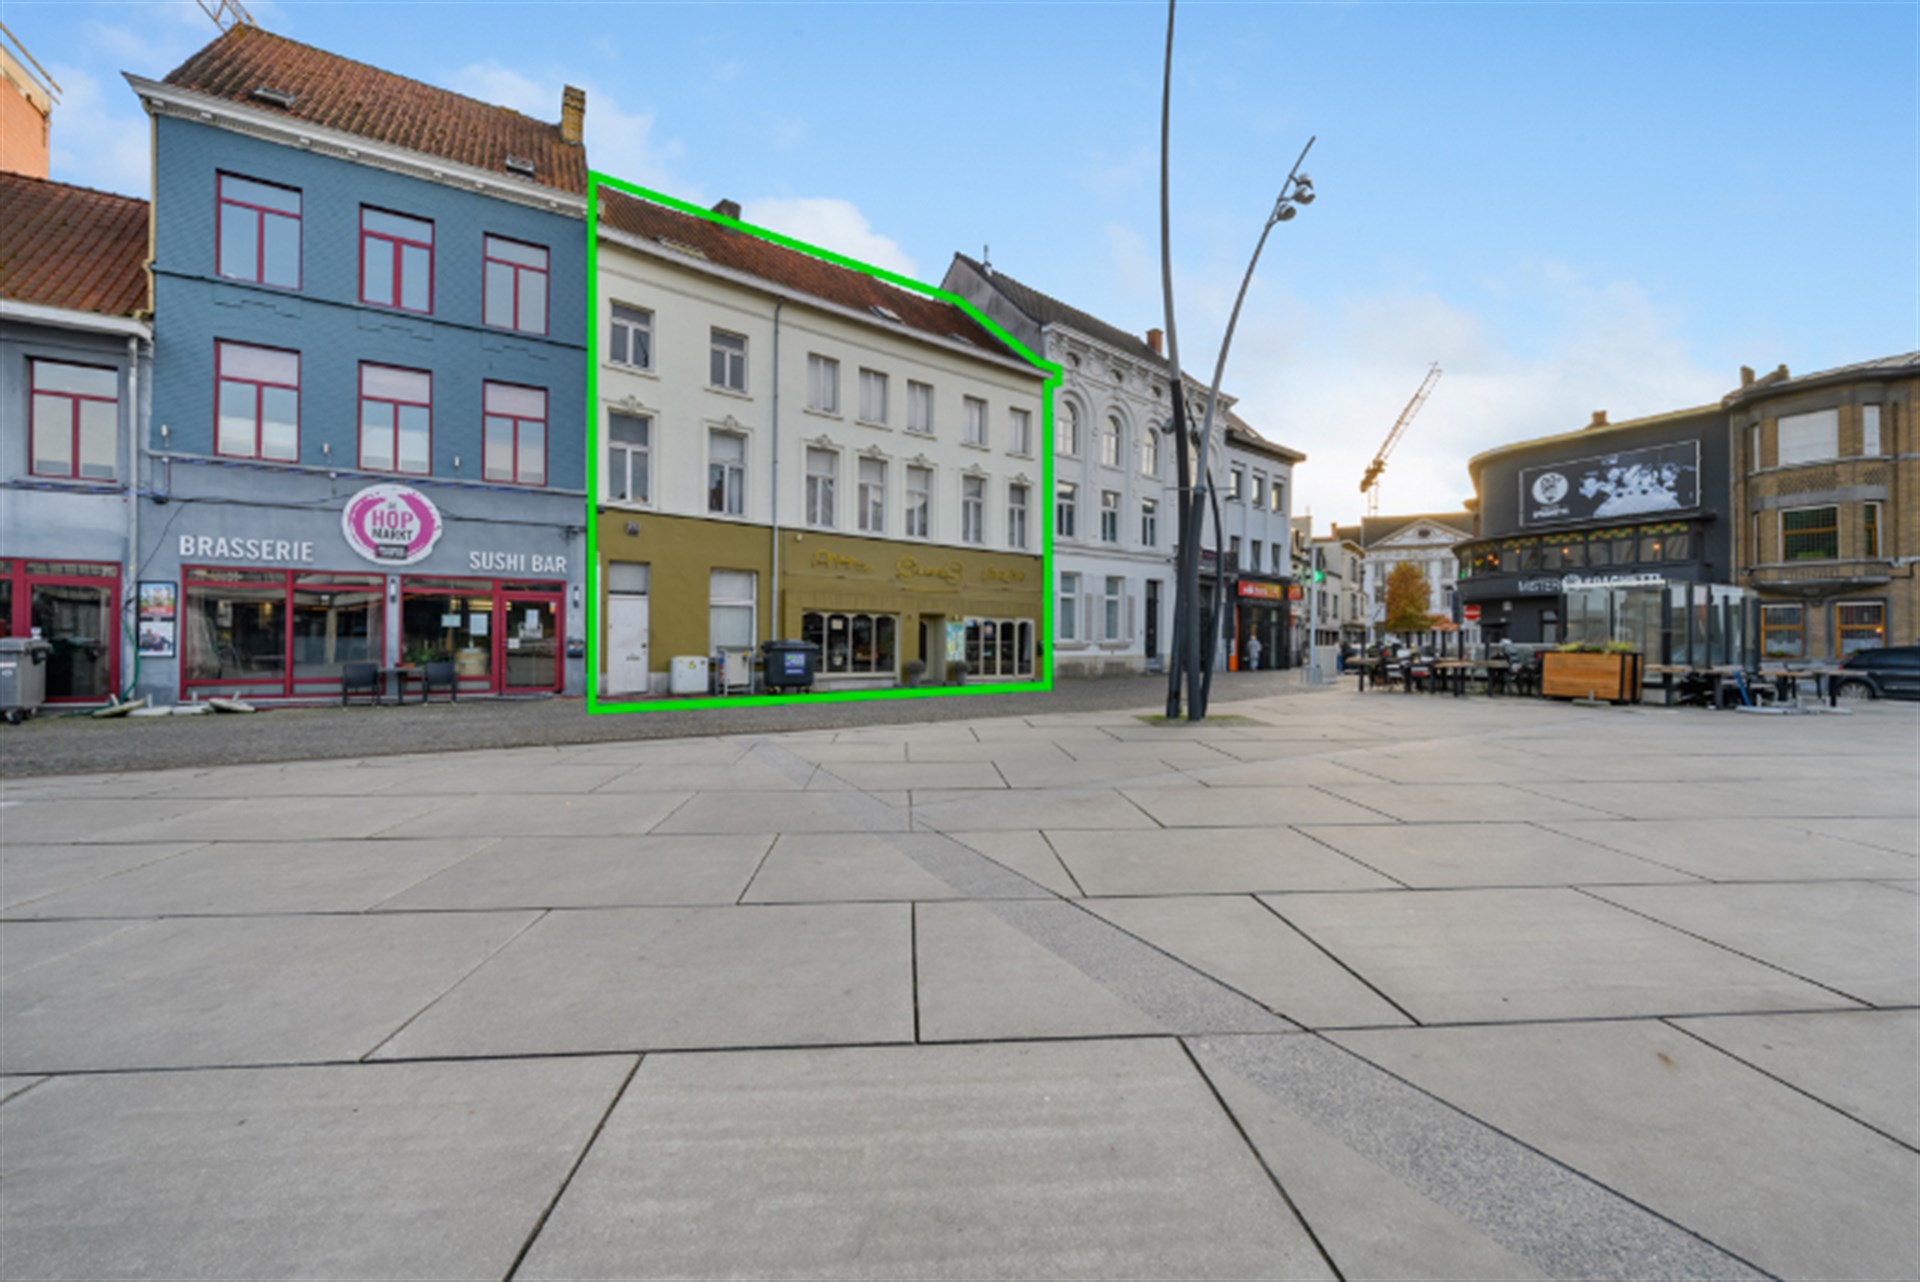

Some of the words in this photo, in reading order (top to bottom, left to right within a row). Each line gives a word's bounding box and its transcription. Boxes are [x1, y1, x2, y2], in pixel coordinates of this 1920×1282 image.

[372, 510, 413, 529] HOP
[372, 528, 412, 541] MARKT
[179, 534, 315, 561] BRASSERIE
[469, 551, 525, 572] SUSHI
[532, 554, 567, 573] BAR
